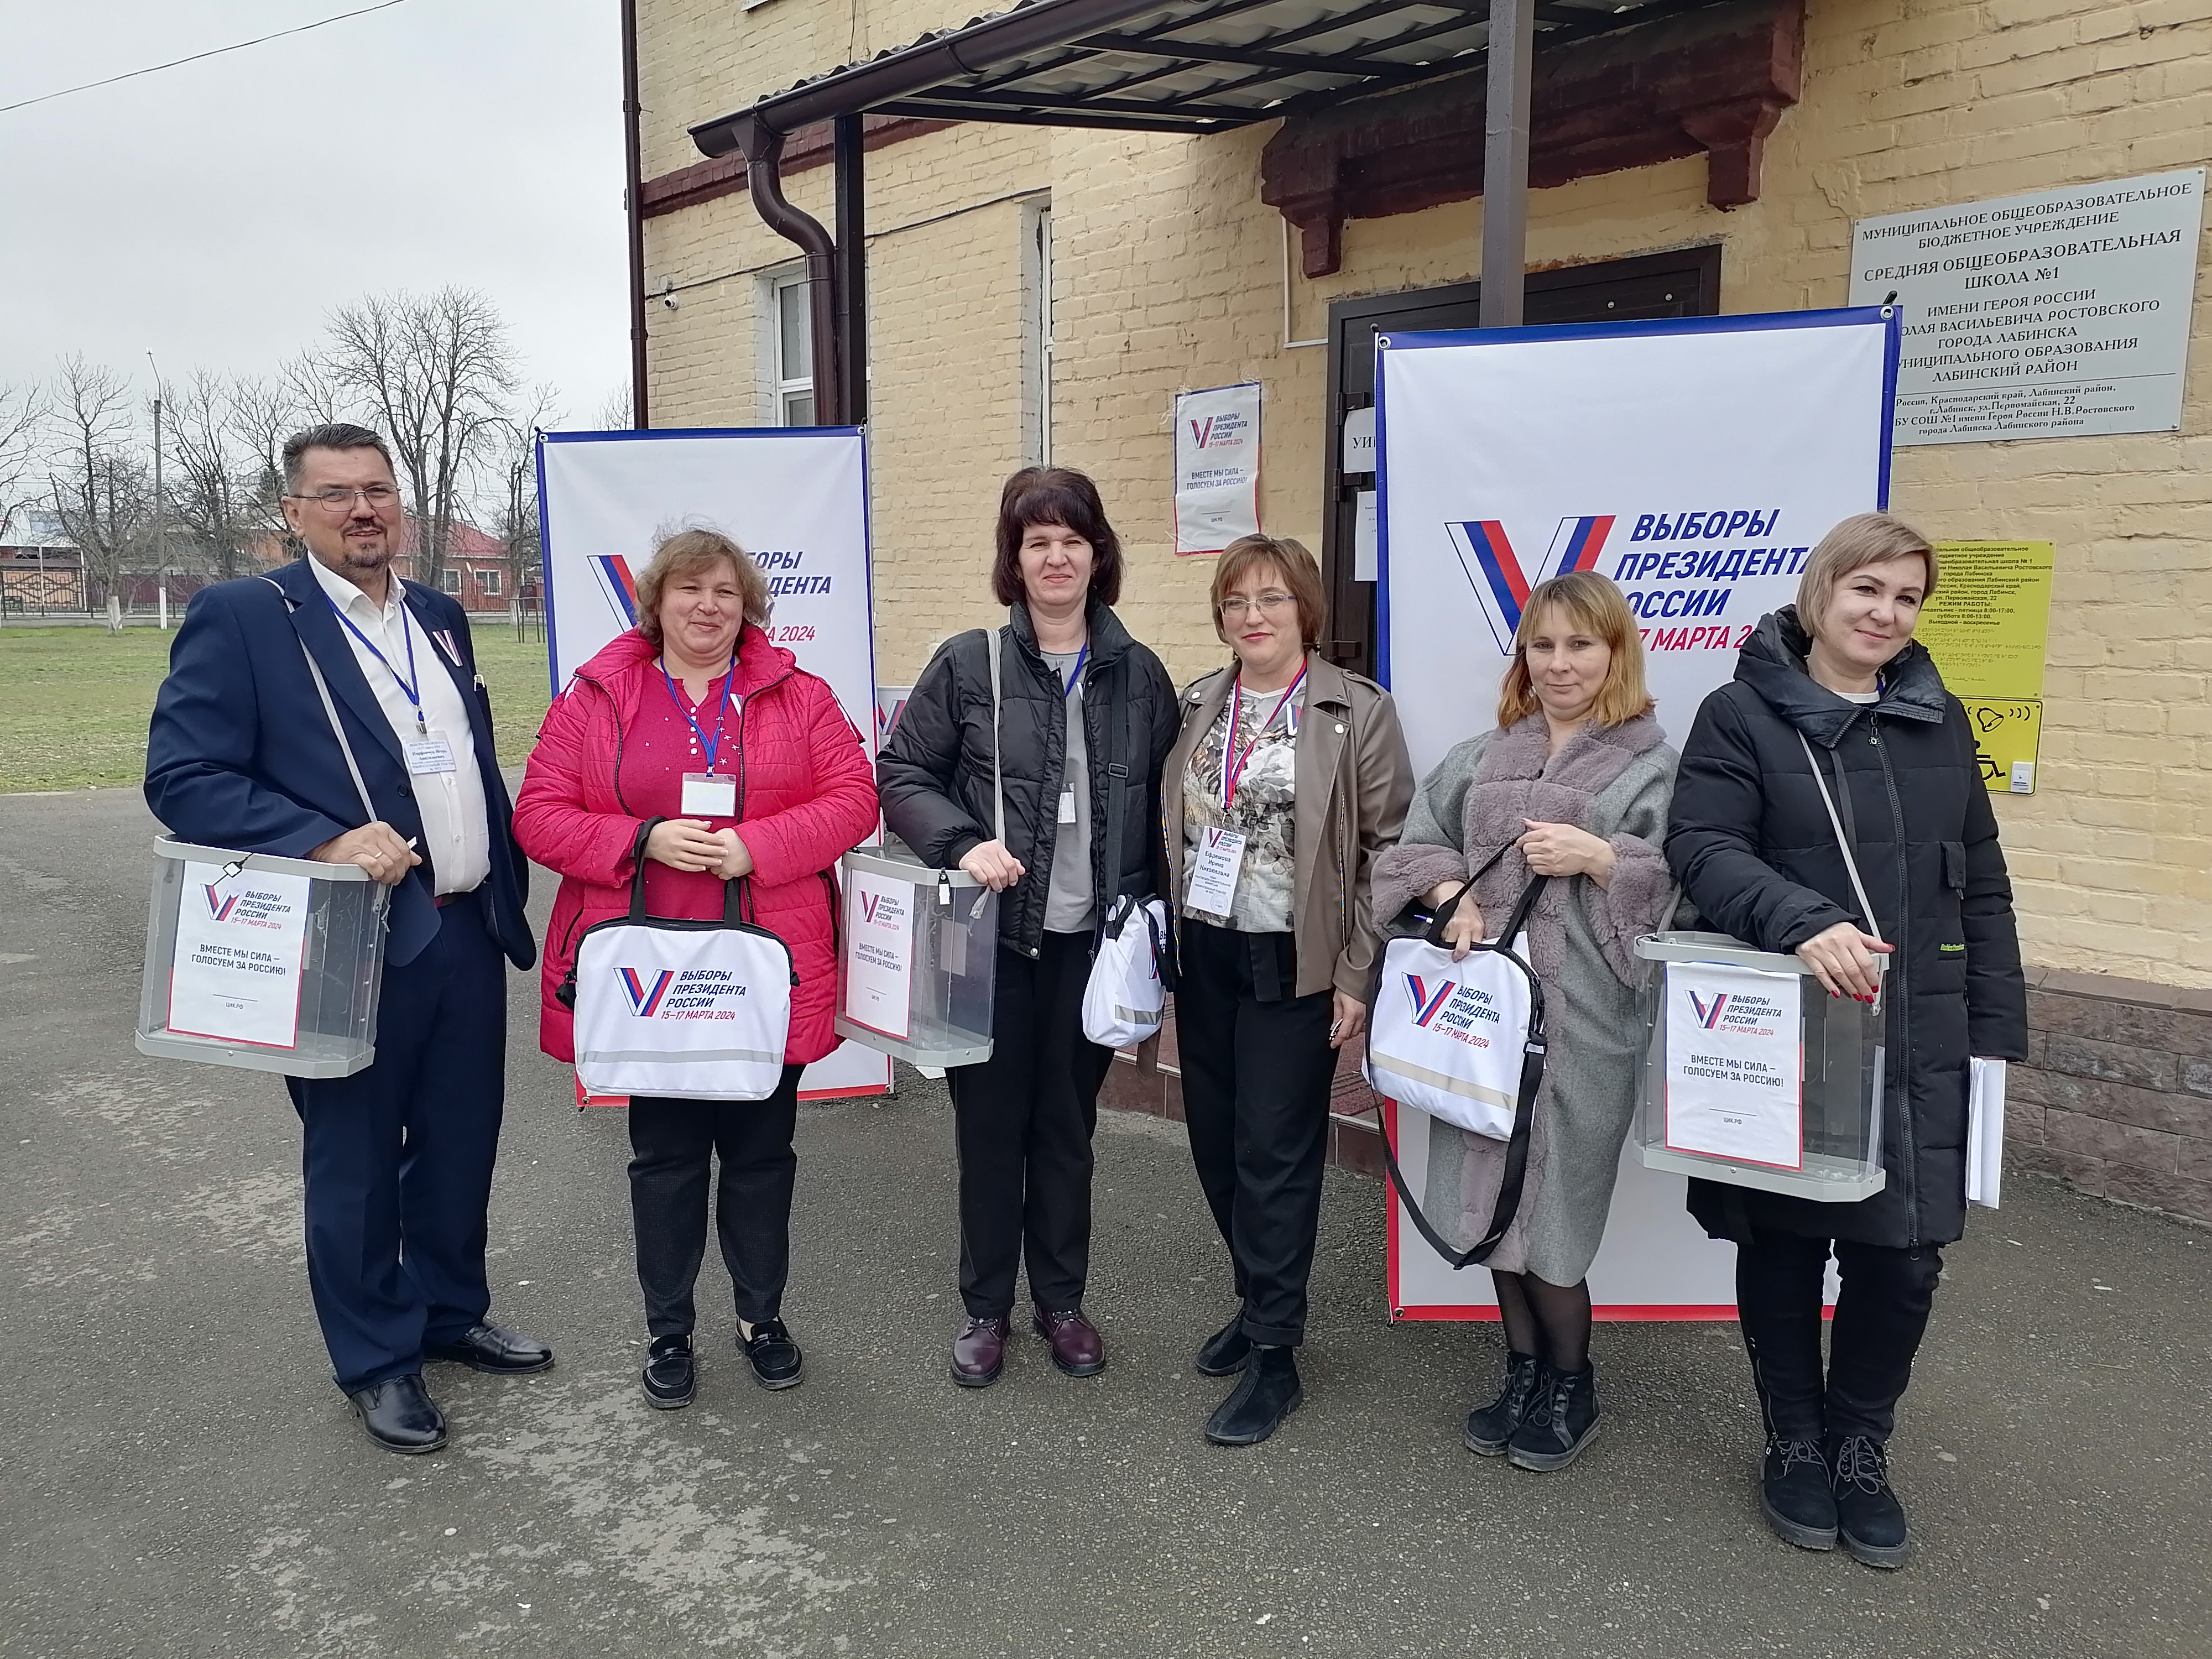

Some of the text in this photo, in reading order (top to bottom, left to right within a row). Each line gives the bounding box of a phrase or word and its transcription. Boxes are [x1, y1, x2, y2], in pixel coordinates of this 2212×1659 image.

[1862, 182, 2192, 241] МУНИЦИПАЛЬНОЕ ОБЩЕОБРАЗОВАТЕЛЬНОЕ
[1918, 211, 2119, 249] БЮДЖЕТНОЕ УЧРЕЖДЕНИЕ
[1864, 229, 2182, 281] СРЕДНЯЯ ОБЩЕОБРАЗОВАТЕЛЬНАЯ
[1965, 267, 2059, 289] ШКОЛА №1
[1927, 289, 2095, 317] ИМЕНИ ГЕРОЯ РОССИИ
[1901, 300, 2159, 336] ОЛАЯ ВАСИЛЬЕВИЧА РОСТОВСКОГО
[1938, 326, 2078, 349] ГОРОДА ЛАБИНСКА
[1898, 338, 2138, 369] УНИЦИПАЛЬНОГО ОБРАЗОВАНИЯ
[1932, 359, 2078, 382] ЛАБИНСКИЙ РАЙОН
[1896, 384, 2116, 406] Россия, Краснодарский край, Лабинский район,
[2063, 396, 2075, 405] 22
[1213, 420, 1248, 431] ПРЕЗИДЕНТА
[1215, 413, 1240, 422] ВЫБОРЫ
[1895, 418, 1908, 426] БУ
[1911, 416, 1937, 425] СОШ
[1940, 414, 1956, 423] №1
[1988, 411, 2013, 420] Героя
[2016, 410, 2049, 418] России
[1949, 424, 1992, 432] Лабинска
[1994, 421, 2048, 430] Лабинского
[2051, 418, 2084, 428] района
[1210, 431, 1233, 440] РОССИИ
[1192, 467, 1239, 479] ВМЕСТЕ МЫ СИЛА
[1187, 480, 1214, 490] ГОЛОСУЕМ
[1223, 477, 1248, 486] РОССИЮ!
[1630, 509, 1781, 541] ВЫБОРЫ
[768, 576, 831, 597] ДЕНТА
[1626, 588, 1732, 618] ОССИИ
[778, 625, 816, 641] 2024
[1650, 625, 1730, 651] МАРТА
[245, 890, 282, 902] ВЫБОРЫ
[880, 895, 900, 906] ВЫБОРЫ
[234, 909, 268, 919] РОССИИ
[239, 899, 291, 914] ПРЕЗИДЕНТА
[878, 904, 905, 916] ПРЕЗИДЕНТА
[875, 911, 892, 921] РОССИИ
[247, 919, 268, 928] МАРТА
[268, 922, 282, 930] 2024
[200, 944, 272, 962] ВМЕСТЕ МЫ СИЛА
[859, 942, 894, 959] ВМЕСТЕ МЫ СИЛА
[191, 954, 286, 975] ГОЛОСУЕМ ЗА РОССИЮ!
[855, 951, 902, 972] ГОЛОСУЕМ ЗА РОССИЮ!
[679, 970, 733, 982] ВЫБОРЫ
[672, 984, 747, 997] ПРЕЗИДЕНТА
[1457, 985, 1493, 1005] ВЫБОРЫ
[666, 997, 715, 1008] РОССИИ
[1731, 995, 1770, 1006] ВЫБОРЫ
[685, 1011, 714, 1020] МАРТА
[715, 1011, 736, 1021] 2024
[1449, 998, 1500, 1024] ПРЕЗИДЕНТА
[1726, 1005, 1782, 1018] ПРЕЗИДЕНТА
[1440, 1011, 1474, 1029] РОССИИ
[1723, 1015, 1758, 1025] РОССИИ
[1737, 1026, 1757, 1035] МАРТА
[1759, 1028, 1774, 1037] 2024
[1468, 1036, 1490, 1048] 2024
[1691, 1055, 1767, 1073] ВМЕСТЕ МЫ СИЛА
[1684, 1066, 1784, 1087] ГОЛОСУЕМ ЗА РОССИЮ!
